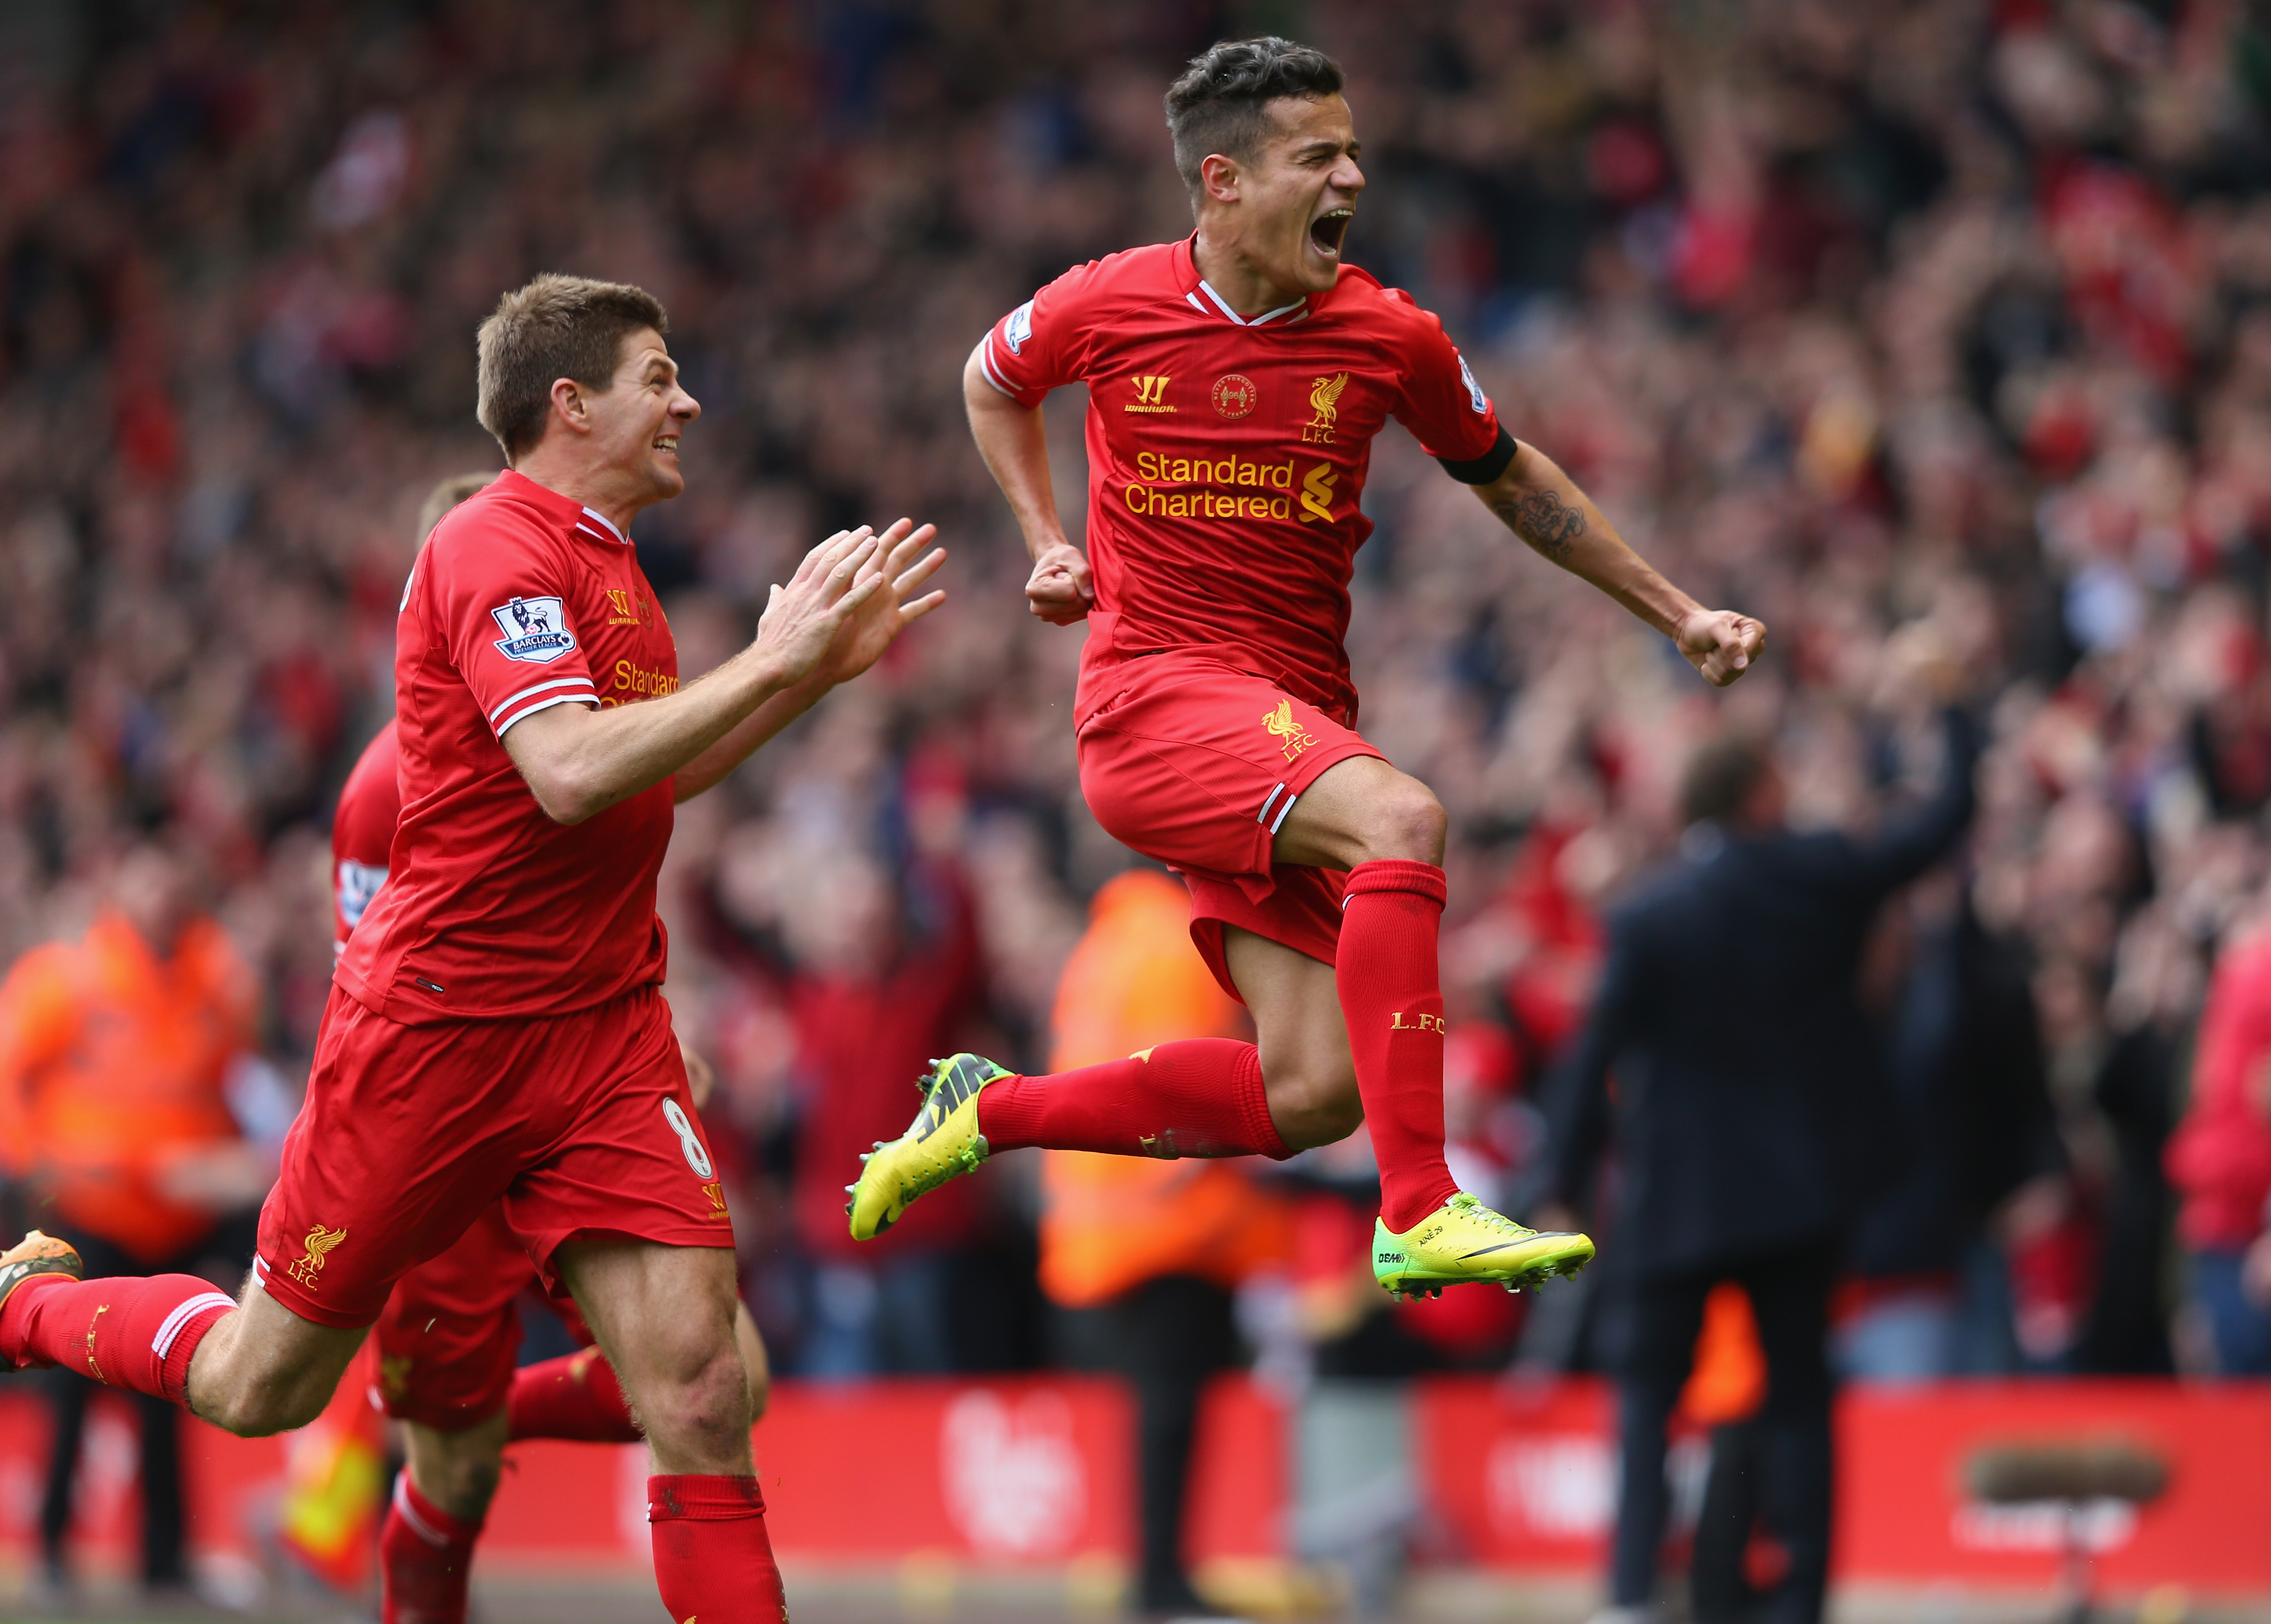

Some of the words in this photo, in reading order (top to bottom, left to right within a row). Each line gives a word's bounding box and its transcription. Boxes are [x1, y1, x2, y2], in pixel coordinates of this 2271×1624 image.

[1137, 451, 1294, 488] Standard
[1125, 484, 1291, 520] Chartered
[513, 635, 556, 650] BARCLAYS
[515, 645, 537, 654] PREMIER
[663, 1097, 713, 1179] 8
